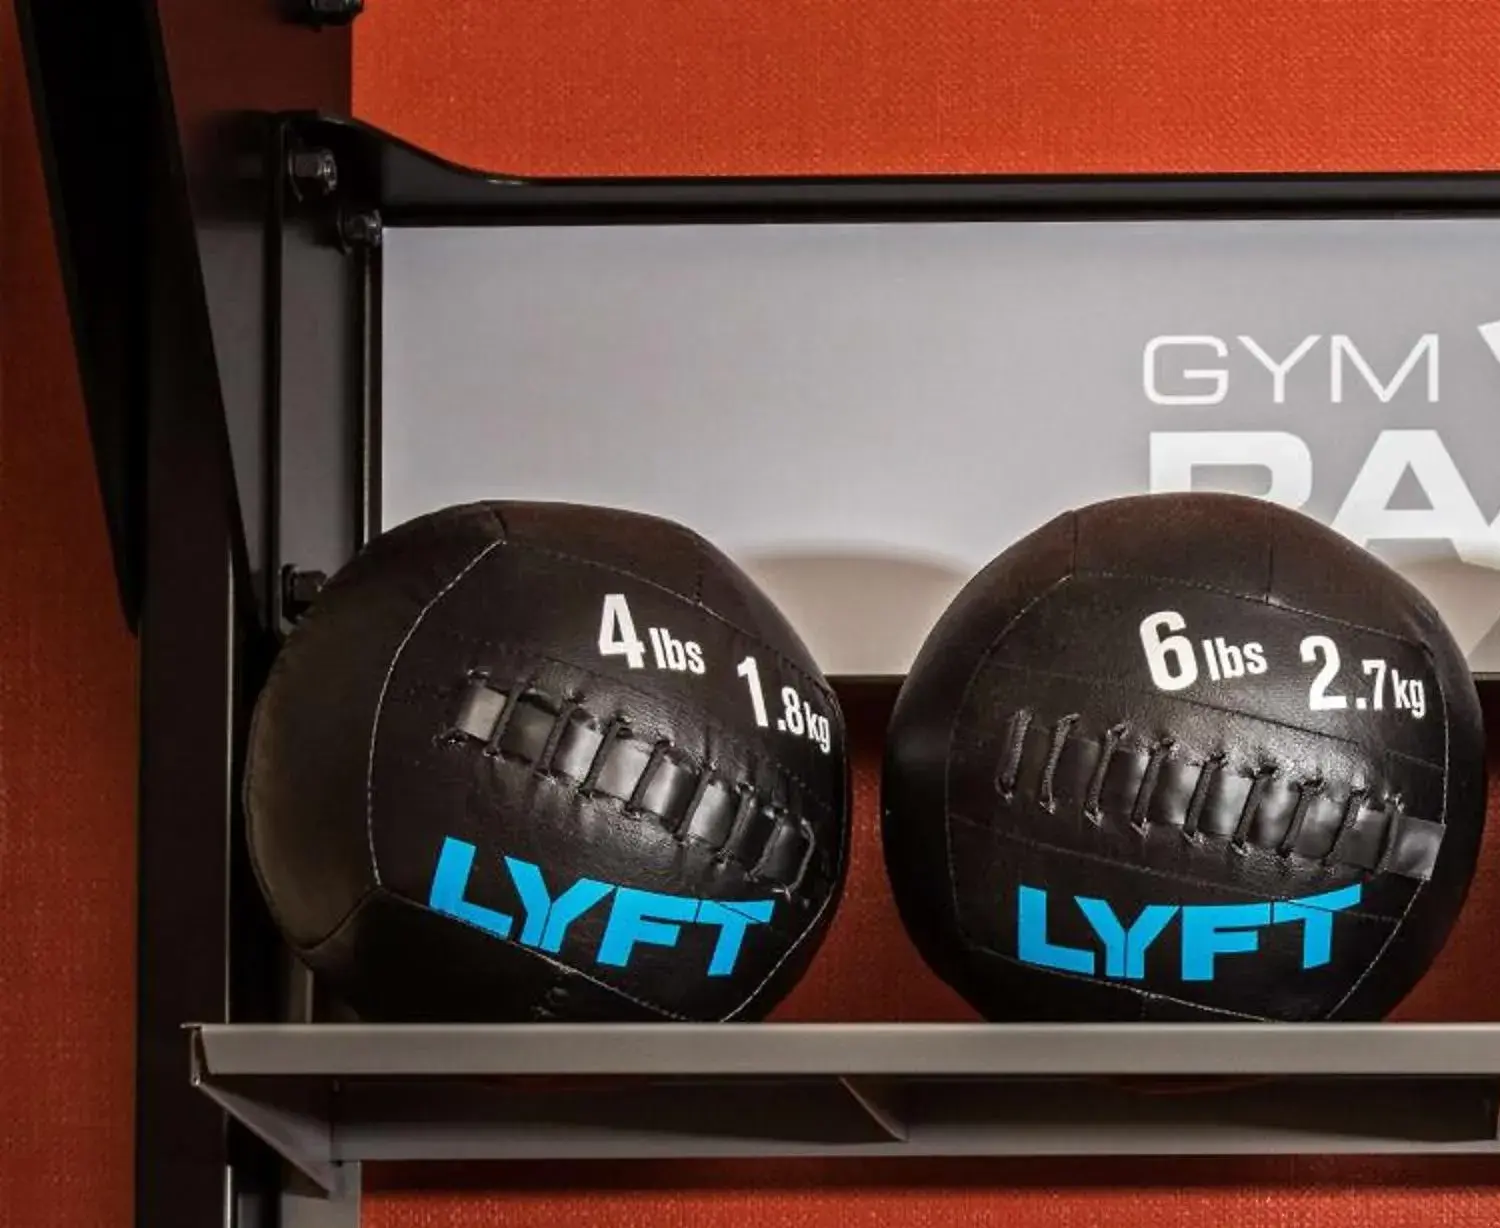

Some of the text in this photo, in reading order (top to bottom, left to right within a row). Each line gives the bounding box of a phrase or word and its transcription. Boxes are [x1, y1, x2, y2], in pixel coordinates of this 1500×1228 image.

[1143, 333, 1439, 406] GYM
[428, 836, 775, 977] LYFT
[1017, 883, 1362, 981] LYFT
